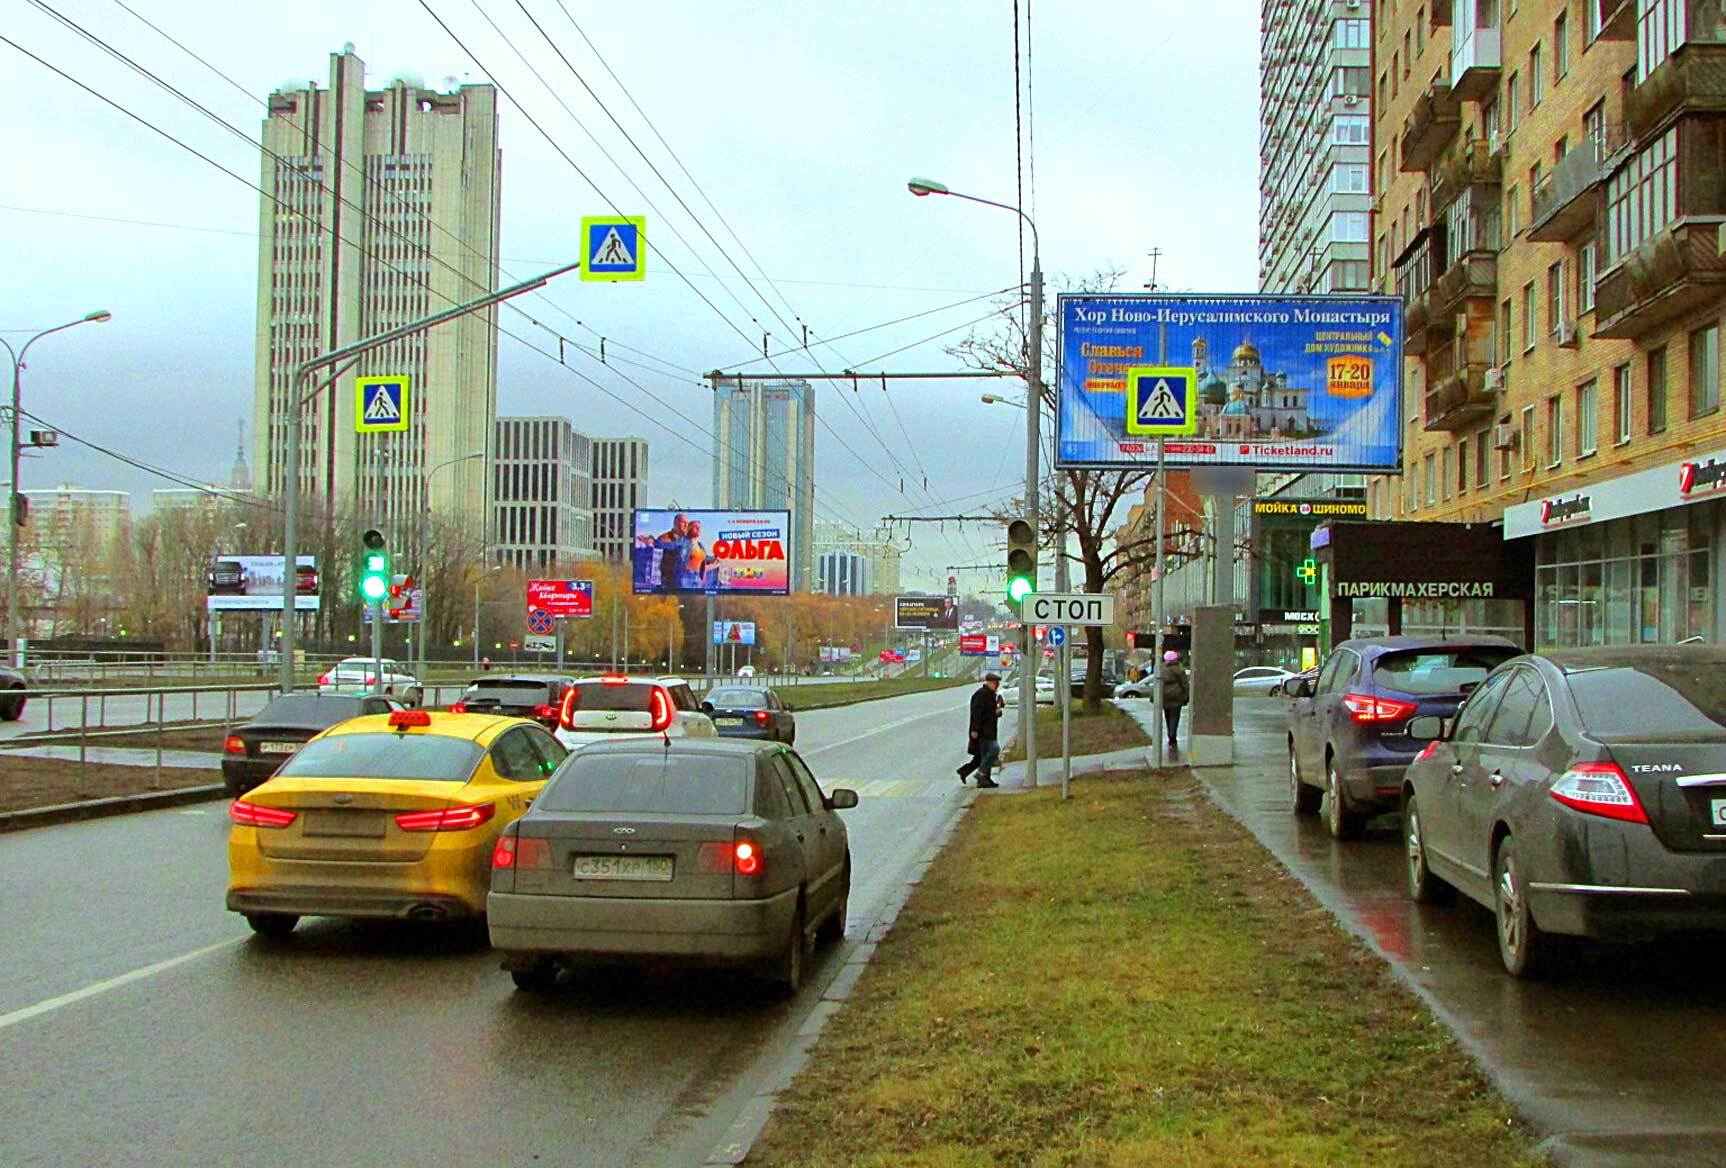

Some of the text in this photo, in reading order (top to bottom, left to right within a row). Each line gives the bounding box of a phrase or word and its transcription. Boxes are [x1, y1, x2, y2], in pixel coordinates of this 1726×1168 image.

[1075, 307, 1390, 327] Хор Ново-Иерусалимского Монастыря
[1330, 363, 1370, 380] 17-20
[1330, 381, 1370, 390] января
[1252, 445, 1333, 456] Ticketland.ru
[1255, 502, 1297, 513] МОЙКА
[752, 530, 777, 538] СЕЗОН
[713, 539, 784, 560] ОЛЬГА
[1338, 582, 1493, 597] ПАРИКМАХЕРСКАЯ
[1035, 600, 1102, 619] СТОП
[1632, 764, 1683, 773] TEANA
